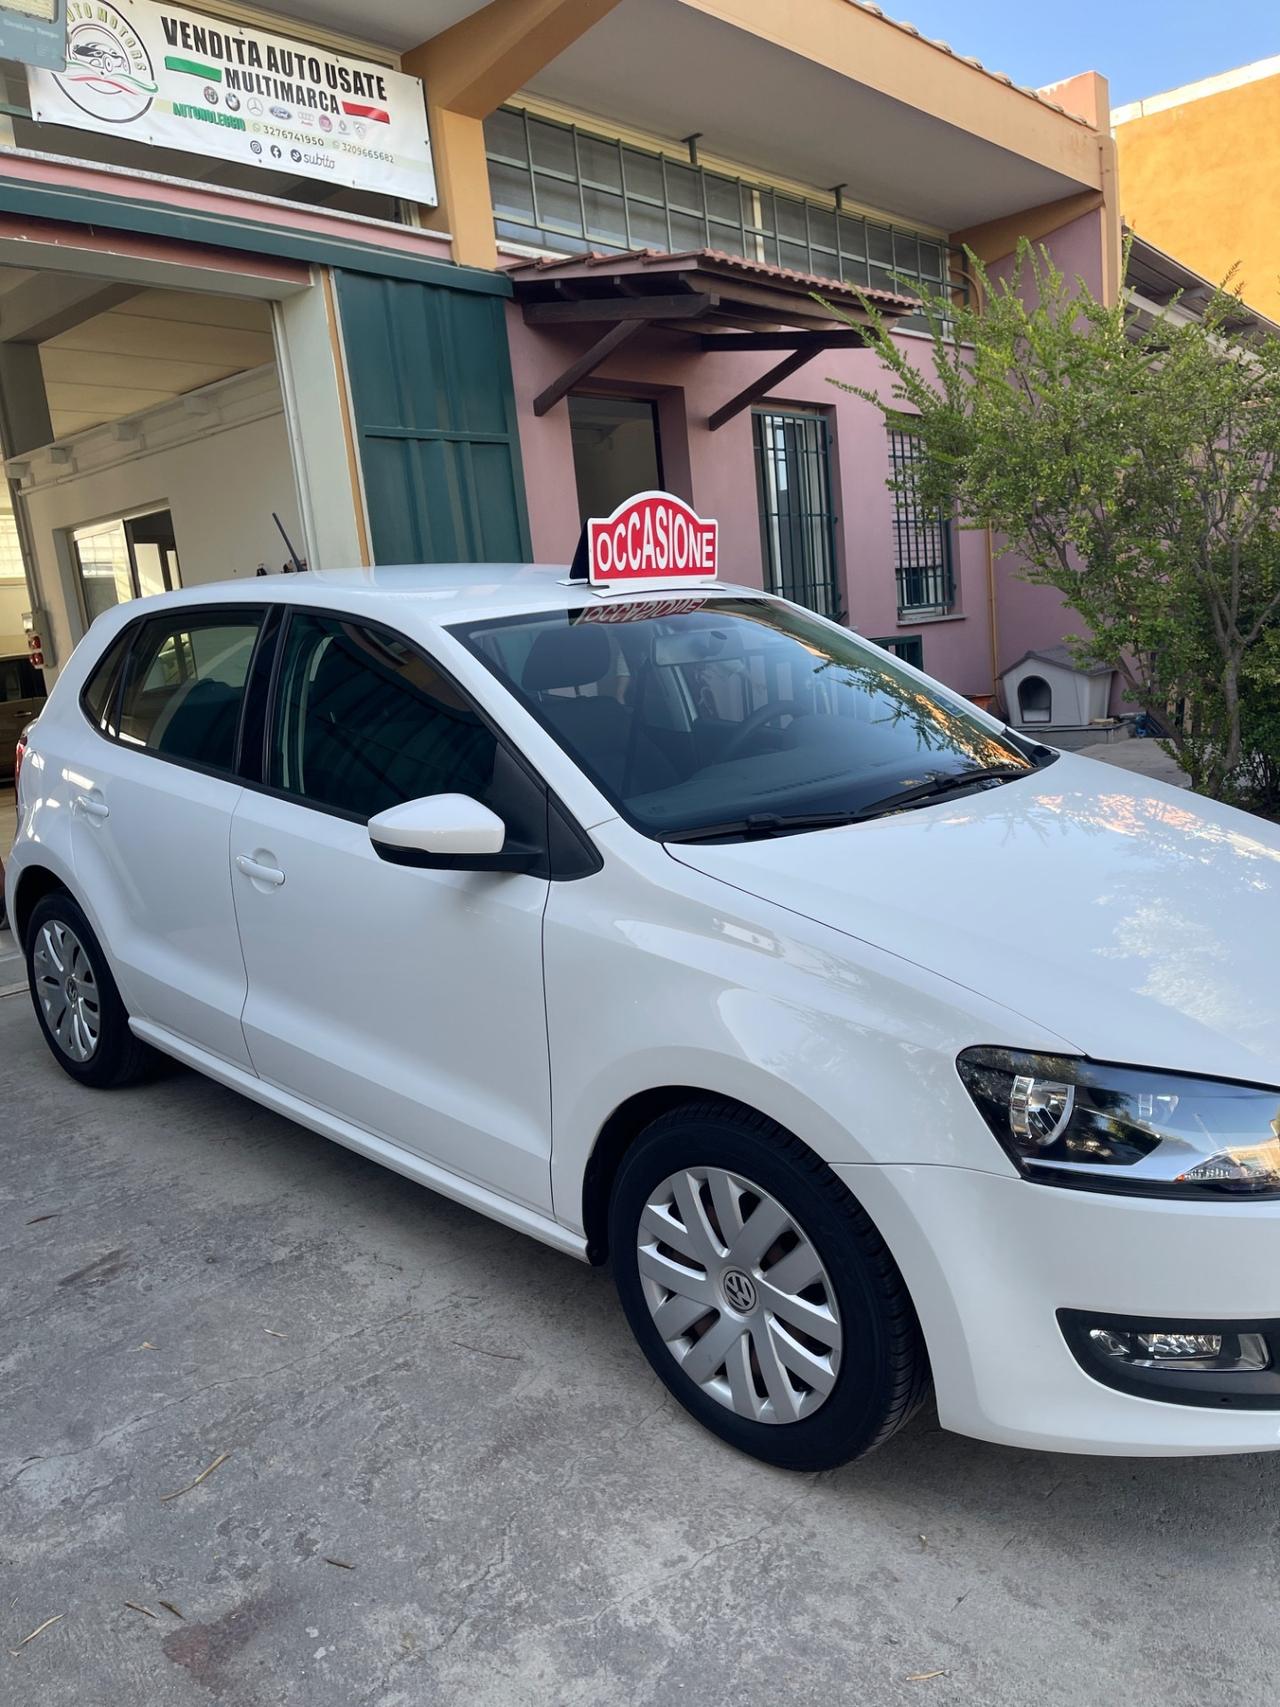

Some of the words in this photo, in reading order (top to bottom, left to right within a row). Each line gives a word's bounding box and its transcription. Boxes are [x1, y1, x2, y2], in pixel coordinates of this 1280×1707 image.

[67, 2, 93, 22] UTO
[97, 6, 147, 71] MOTORS
[160, 16, 263, 68] VENDITA
[267, 45, 321, 84] AUTO
[324, 62, 388, 101] USATE
[225, 67, 340, 115] MULTIMARCA
[263, 125, 324, 147] 3276741950
[342, 142, 394, 164] 3209665682
[303, 152, 336, 169] subito
[596, 505, 714, 572] OCCASIONE
